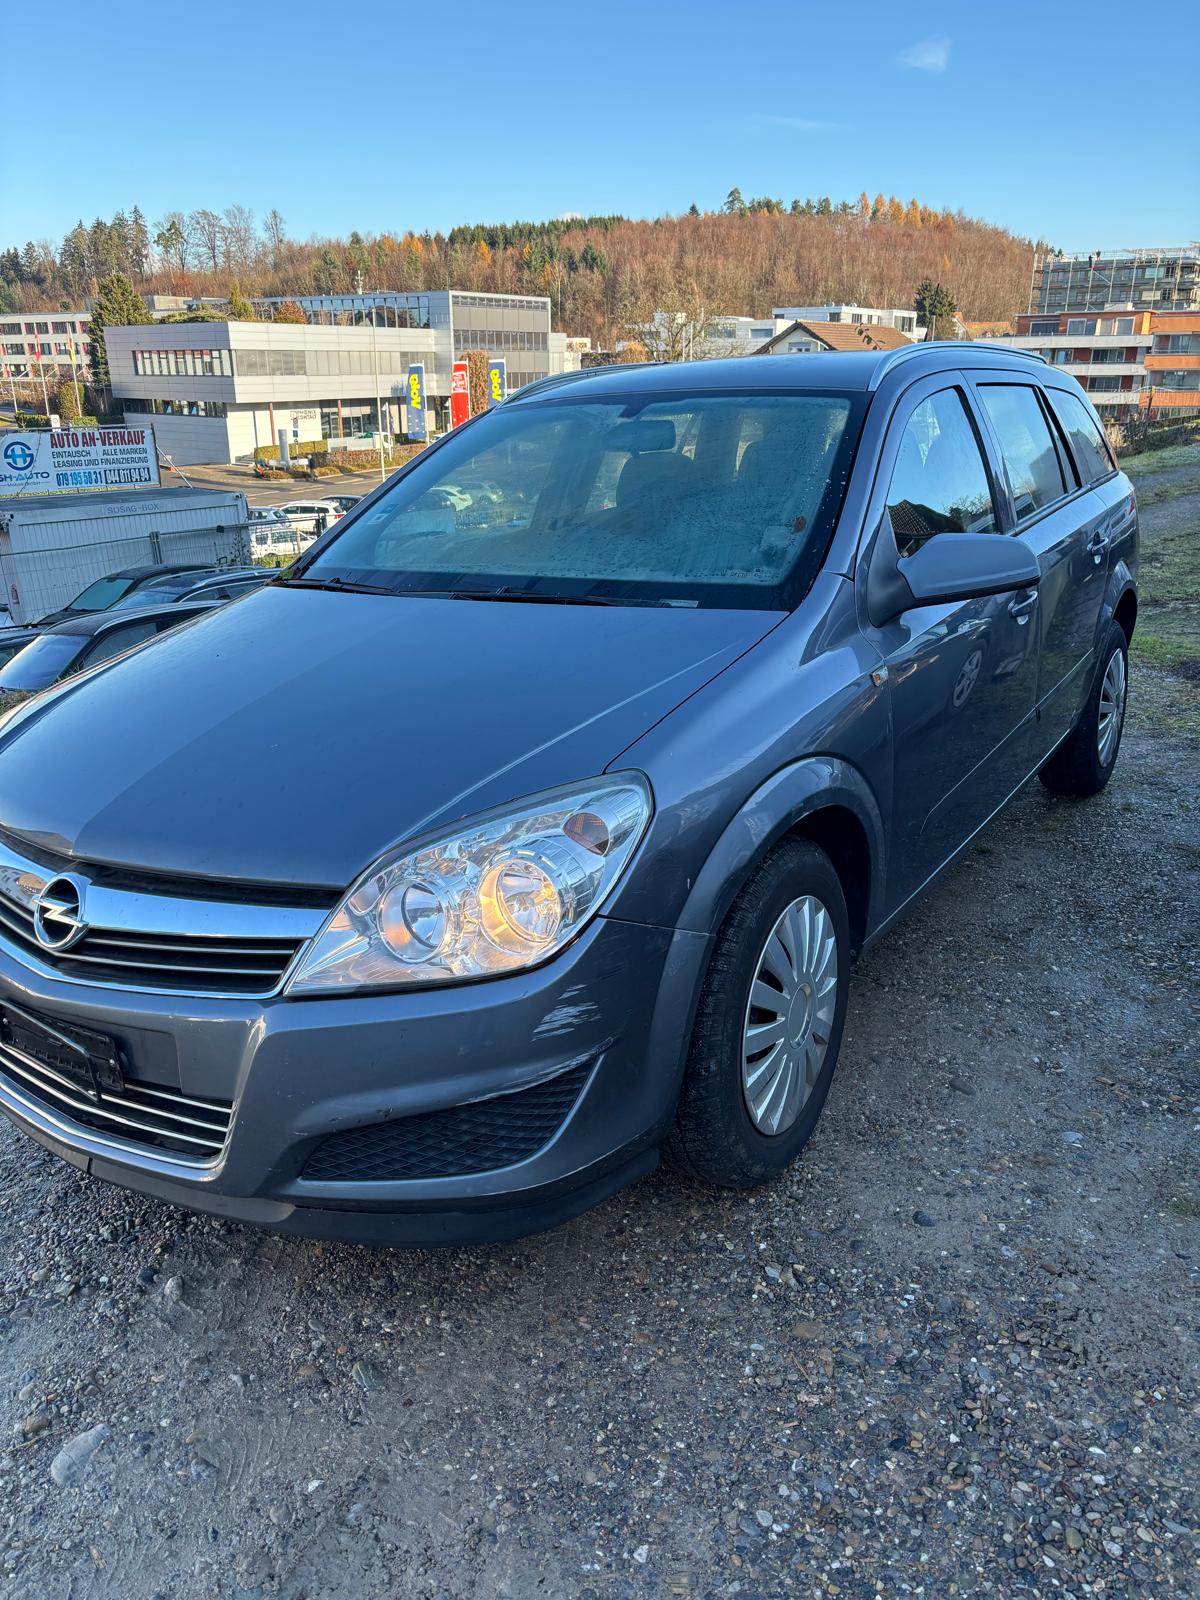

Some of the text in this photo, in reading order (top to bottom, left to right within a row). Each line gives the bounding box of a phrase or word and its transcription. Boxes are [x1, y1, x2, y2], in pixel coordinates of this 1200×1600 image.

[50, 430, 145, 448] AUTO AN-VERKAUF
[52, 448, 147, 458] EINTAUSCH ALLE MARKEN
[53, 456, 148, 468] LEASING UND FINANZIERUNG
[56, 470, 103, 487] 079 195 58 31
[107, 469, 119, 483] 044
